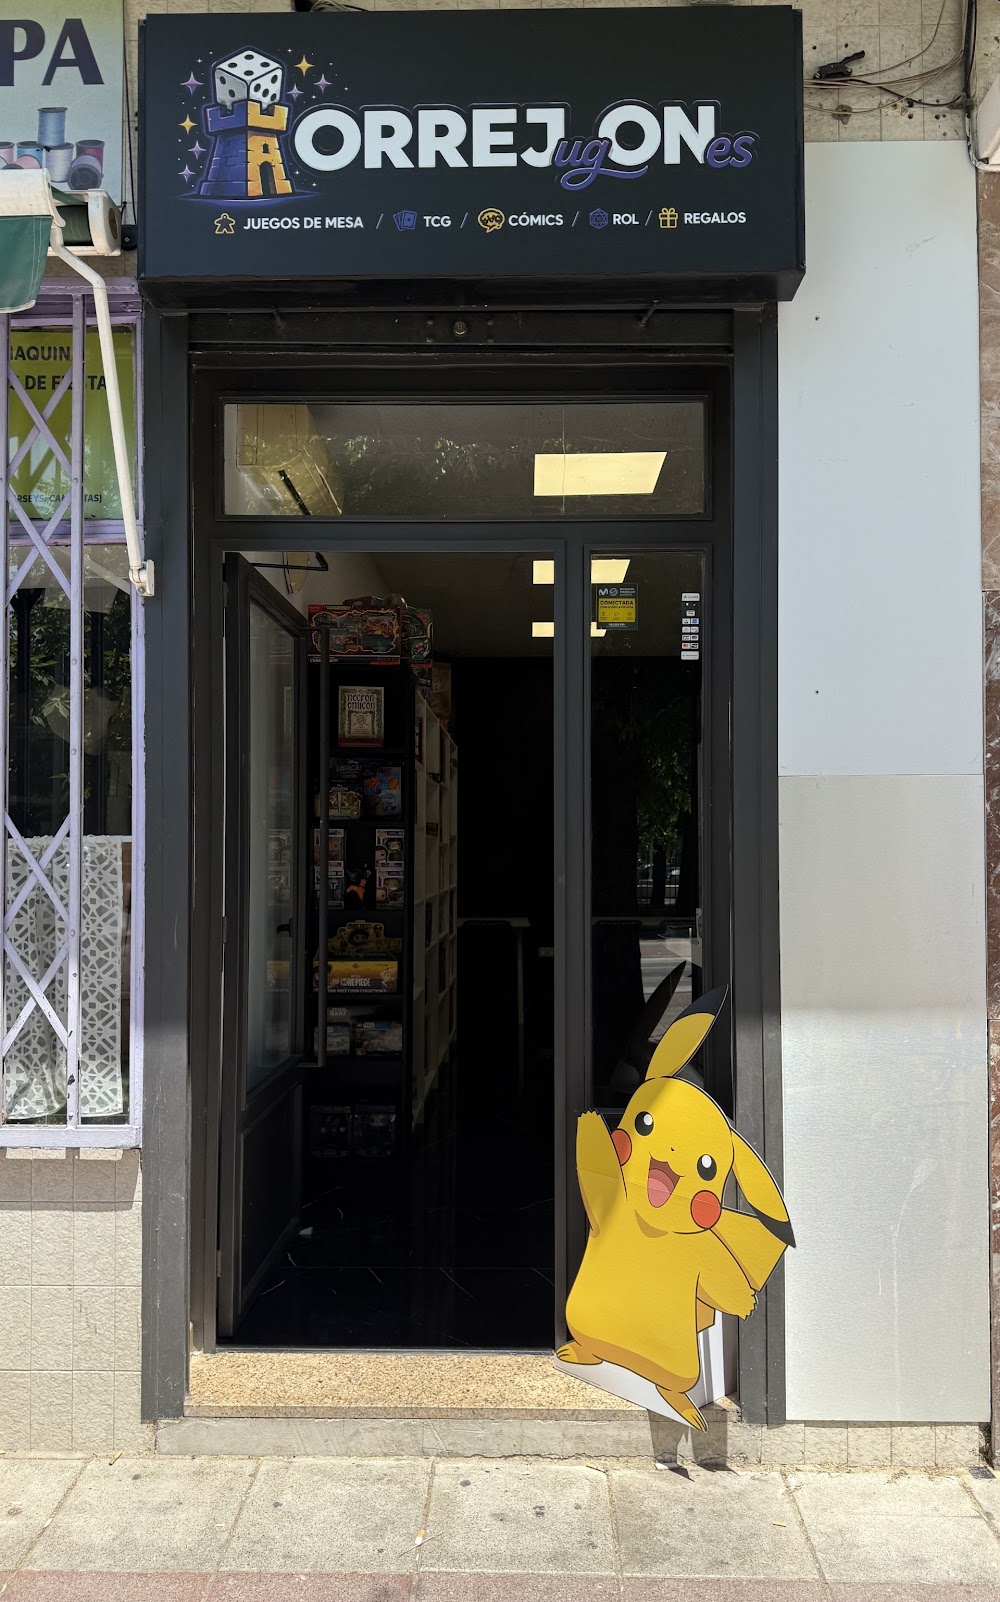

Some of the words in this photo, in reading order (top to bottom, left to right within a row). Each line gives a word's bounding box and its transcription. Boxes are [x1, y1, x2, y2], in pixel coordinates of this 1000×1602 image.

[243, 216, 301, 230] JUEGOS
[303, 216, 322, 229] DE
[325, 216, 364, 229] MESA
[423, 215, 452, 228] TCG
[508, 211, 564, 227] CÓMICS
[612, 213, 640, 225] ROL
[684, 211, 747, 225] REGALOS
[10, 345, 73, 361] AQUIN
[24, 375, 47, 390] DE
